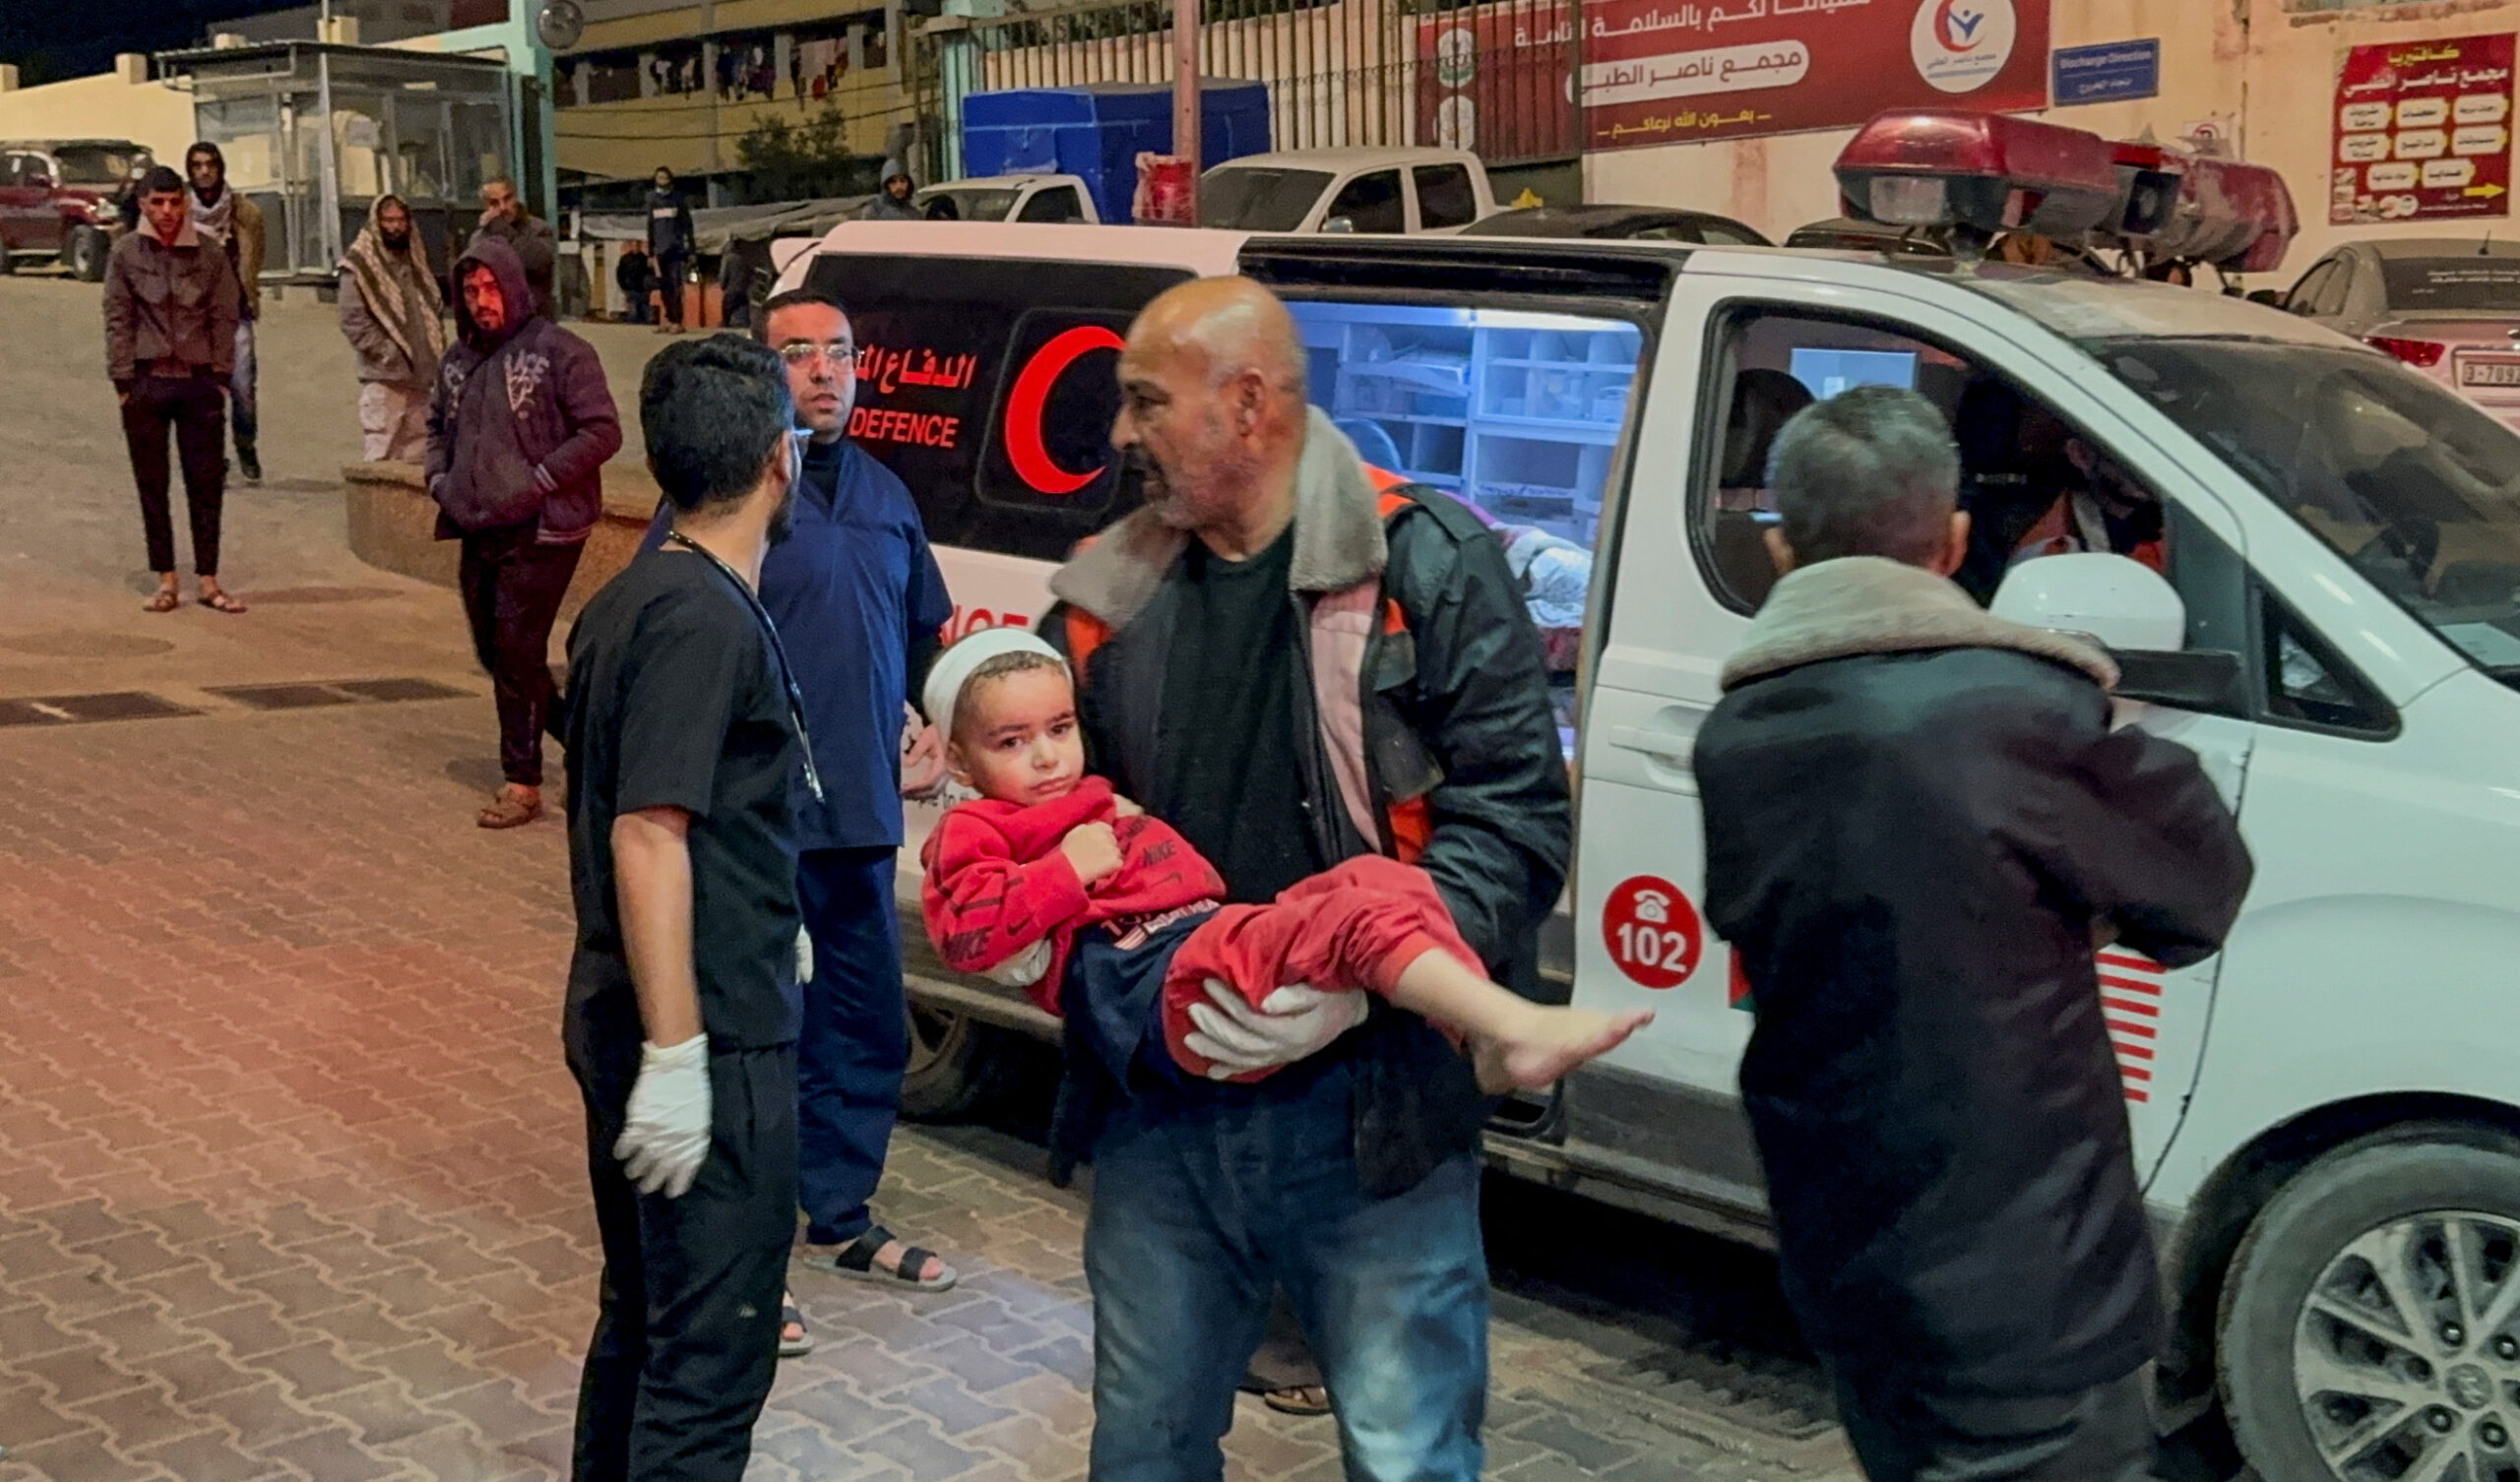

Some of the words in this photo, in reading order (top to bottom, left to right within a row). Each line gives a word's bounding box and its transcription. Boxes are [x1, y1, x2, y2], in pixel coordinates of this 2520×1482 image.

[1592, 8, 1701, 38] بالسلامة
[1649, 56, 1714, 87] ناصر
[1720, 51, 1801, 82] مجمع
[2398, 66, 2457, 92] ناصر
[2460, 68, 2508, 89] مجمع
[1674, 109, 1697, 127] الله
[879, 348, 977, 394] الدفاع
[849, 406, 960, 449] DEFENCE
[1143, 839, 1177, 867] NIKE
[1617, 922, 1687, 974] 102
